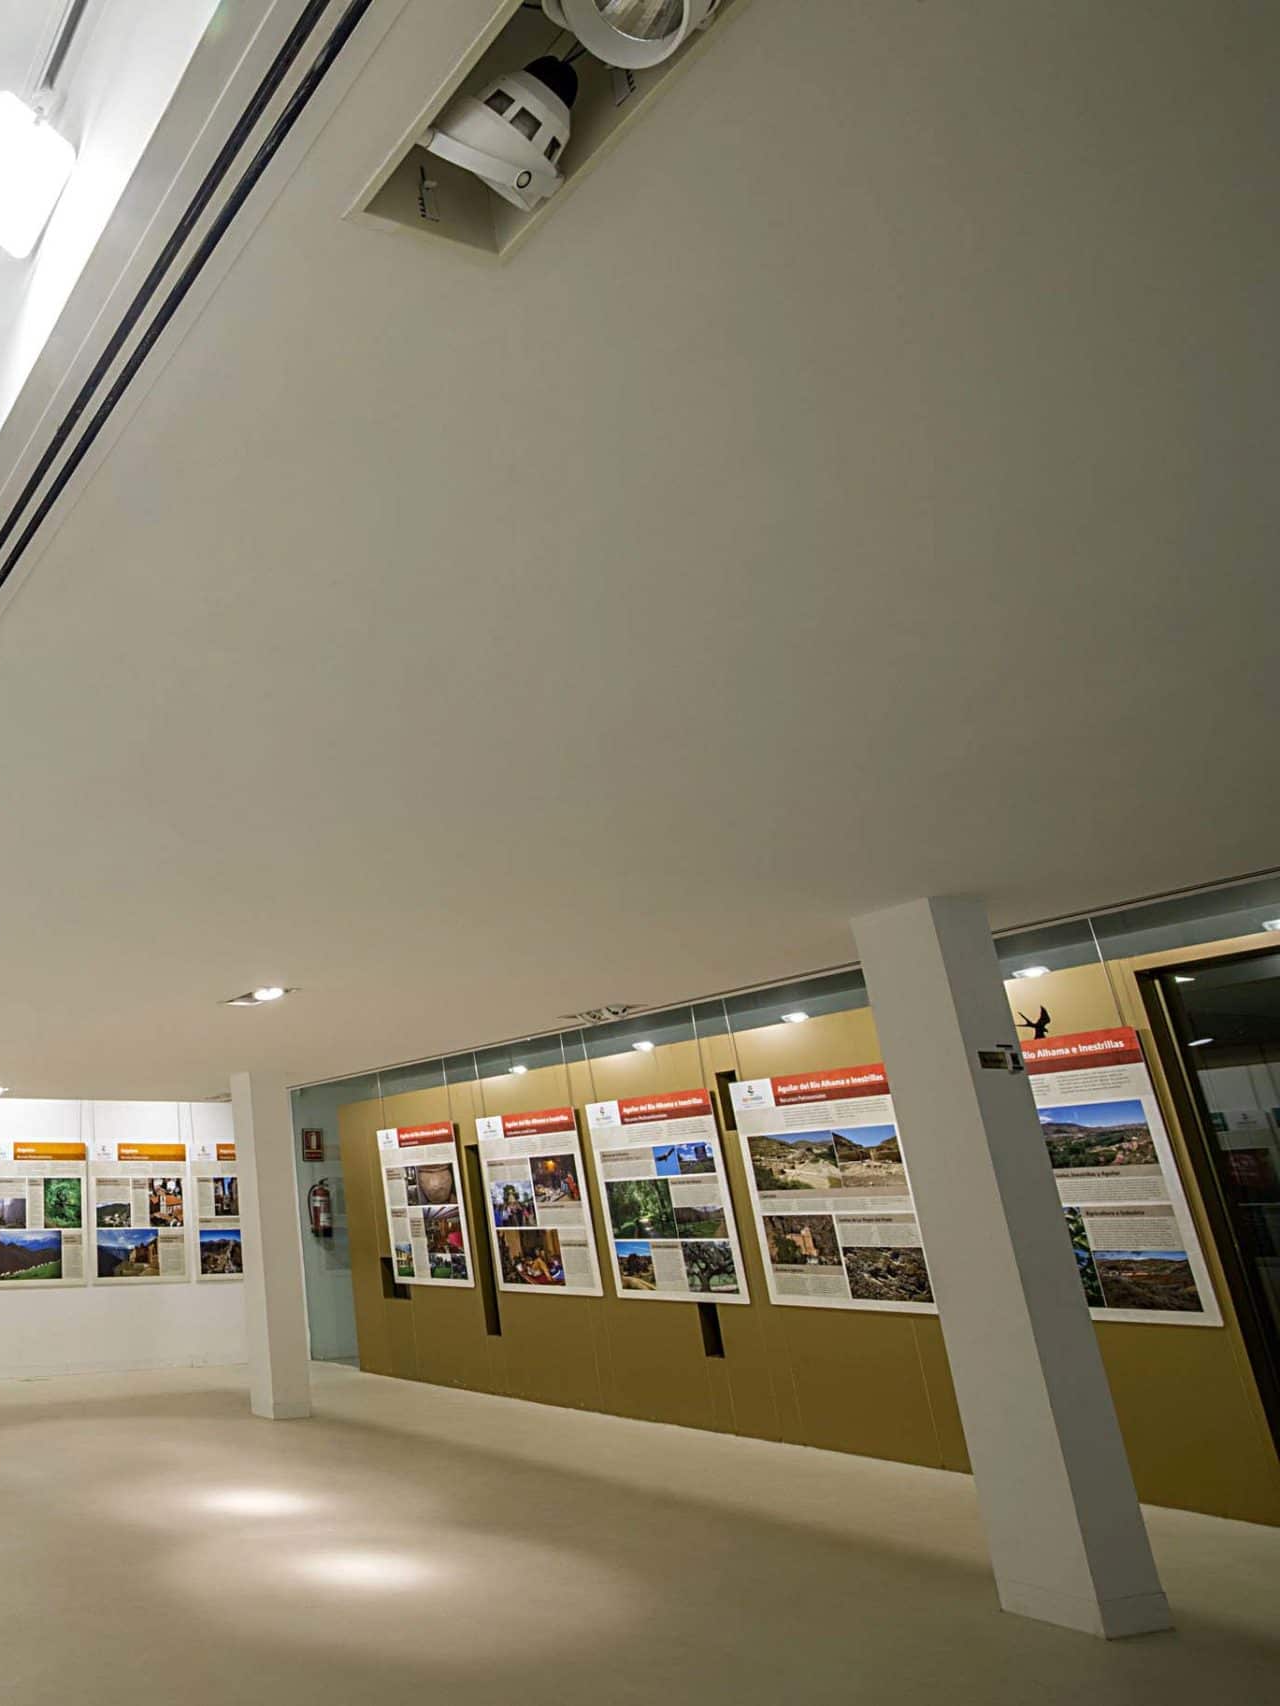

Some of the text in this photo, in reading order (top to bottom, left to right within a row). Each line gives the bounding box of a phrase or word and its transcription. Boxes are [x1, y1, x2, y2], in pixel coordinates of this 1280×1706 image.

[1037, 1046, 1070, 1058] Alhama
[1072, 1046, 1077, 1054] e
[1080, 1040, 1124, 1052] Inestrillas
